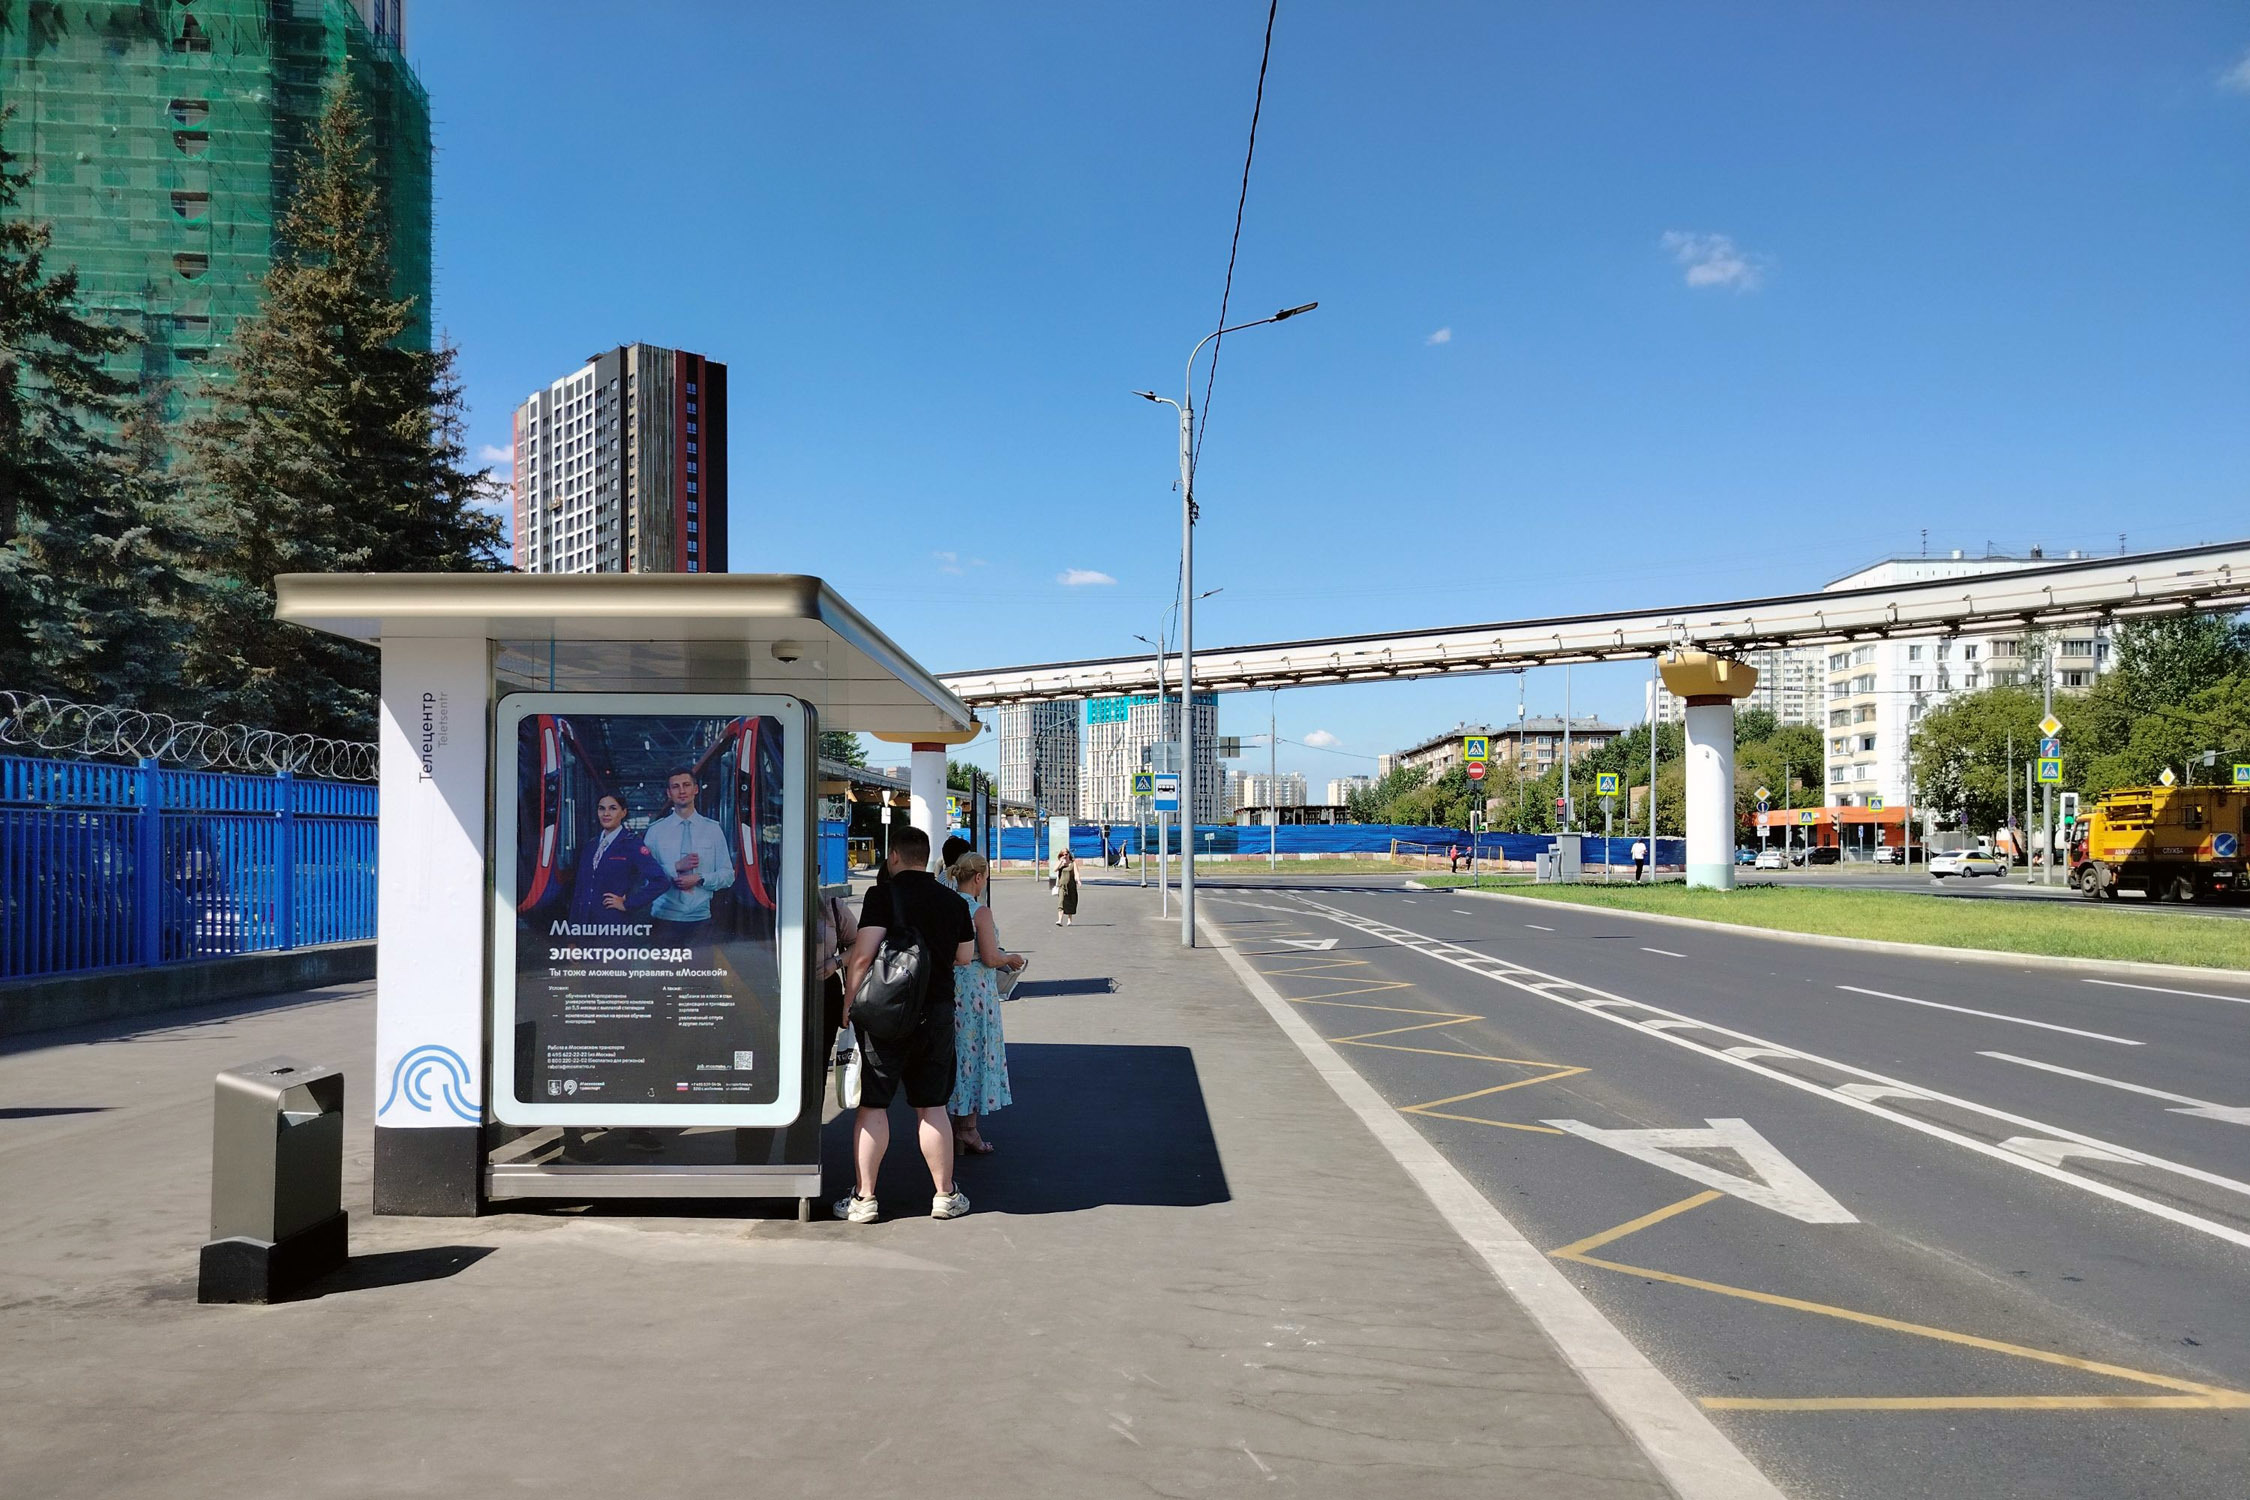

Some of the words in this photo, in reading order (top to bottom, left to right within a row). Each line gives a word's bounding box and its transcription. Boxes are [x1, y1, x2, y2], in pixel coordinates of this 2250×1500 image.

[438, 691, 448, 748] Teletsentr
[419, 692, 436, 784] Телецентр
[549, 919, 653, 936] Машинист
[549, 947, 693, 964] электропоезда
[549, 968, 561, 977] Ты
[563, 969, 586, 977] тоже
[588, 969, 627, 977] можешь
[629, 969, 674, 979] управлять
[676, 968, 728, 977] «Москвой»
